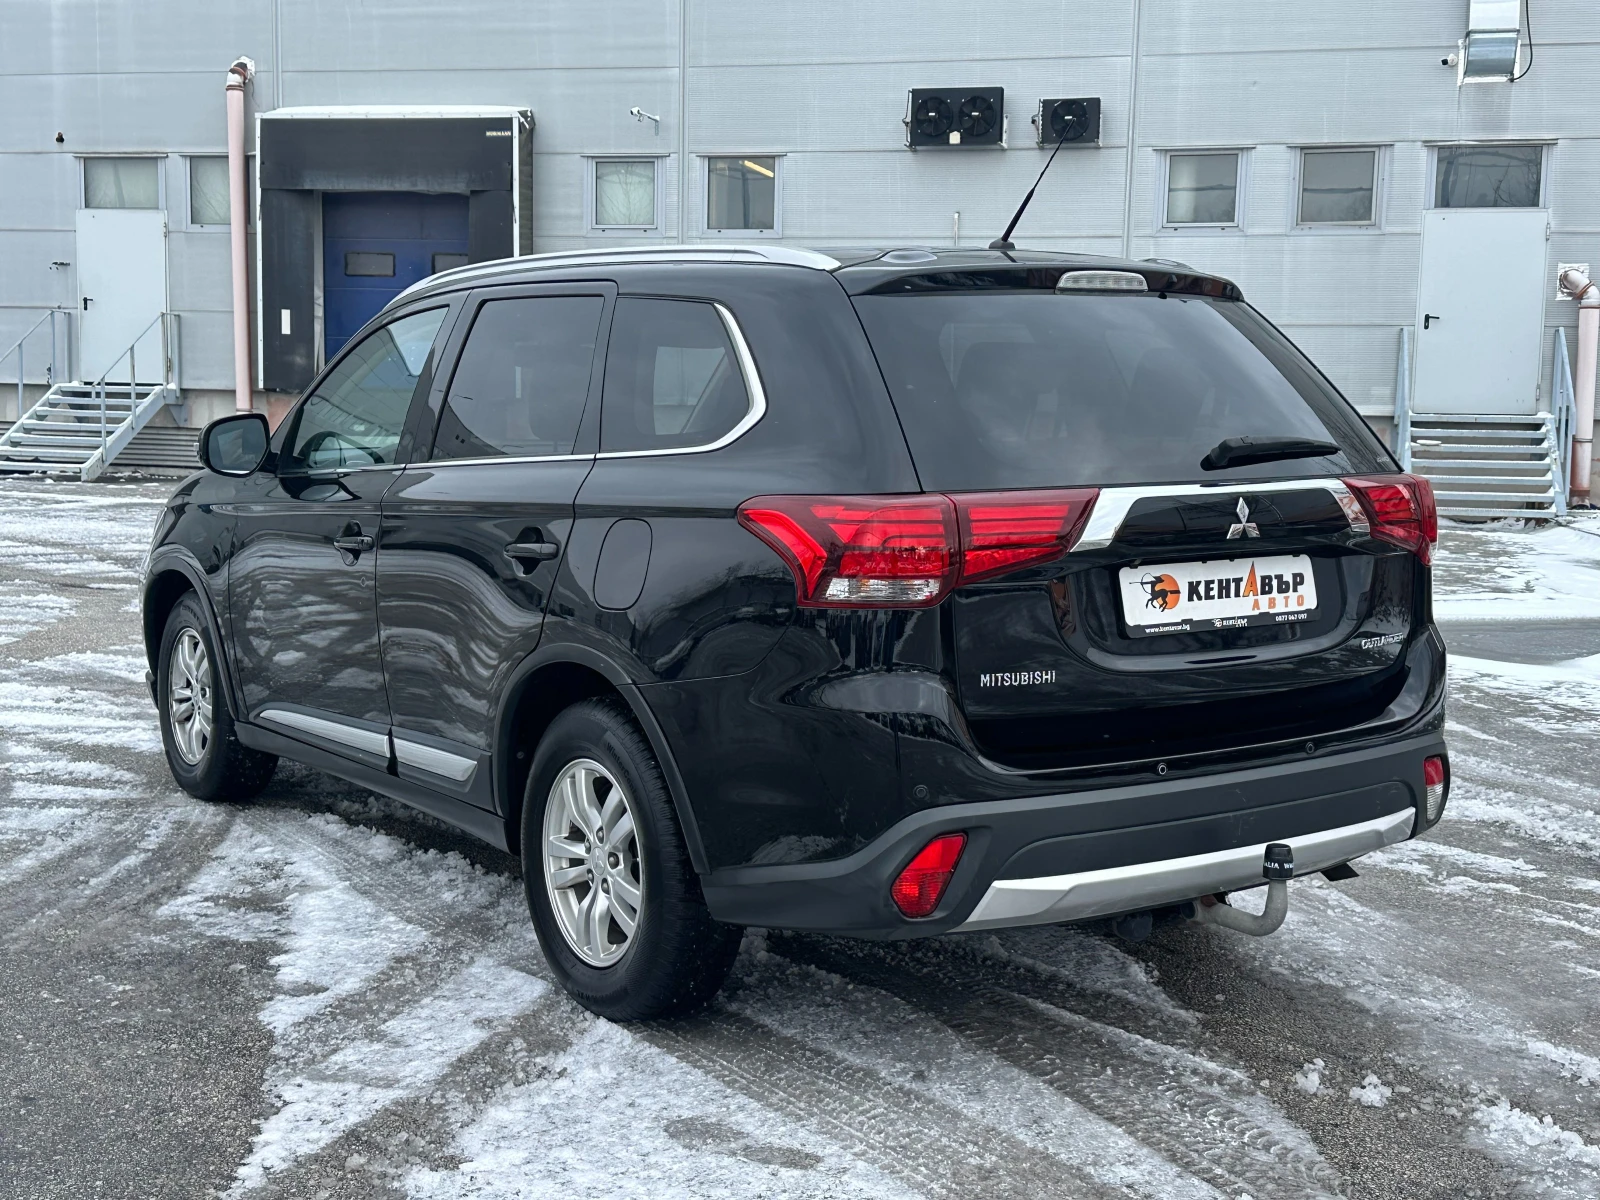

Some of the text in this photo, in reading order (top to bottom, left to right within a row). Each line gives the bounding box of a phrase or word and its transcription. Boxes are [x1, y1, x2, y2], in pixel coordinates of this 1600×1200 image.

[1187, 561, 1305, 602] КЕНТАВЪР
[1252, 594, 1305, 611] АВТО
[980, 670, 1056, 687] MITSUBISHI
